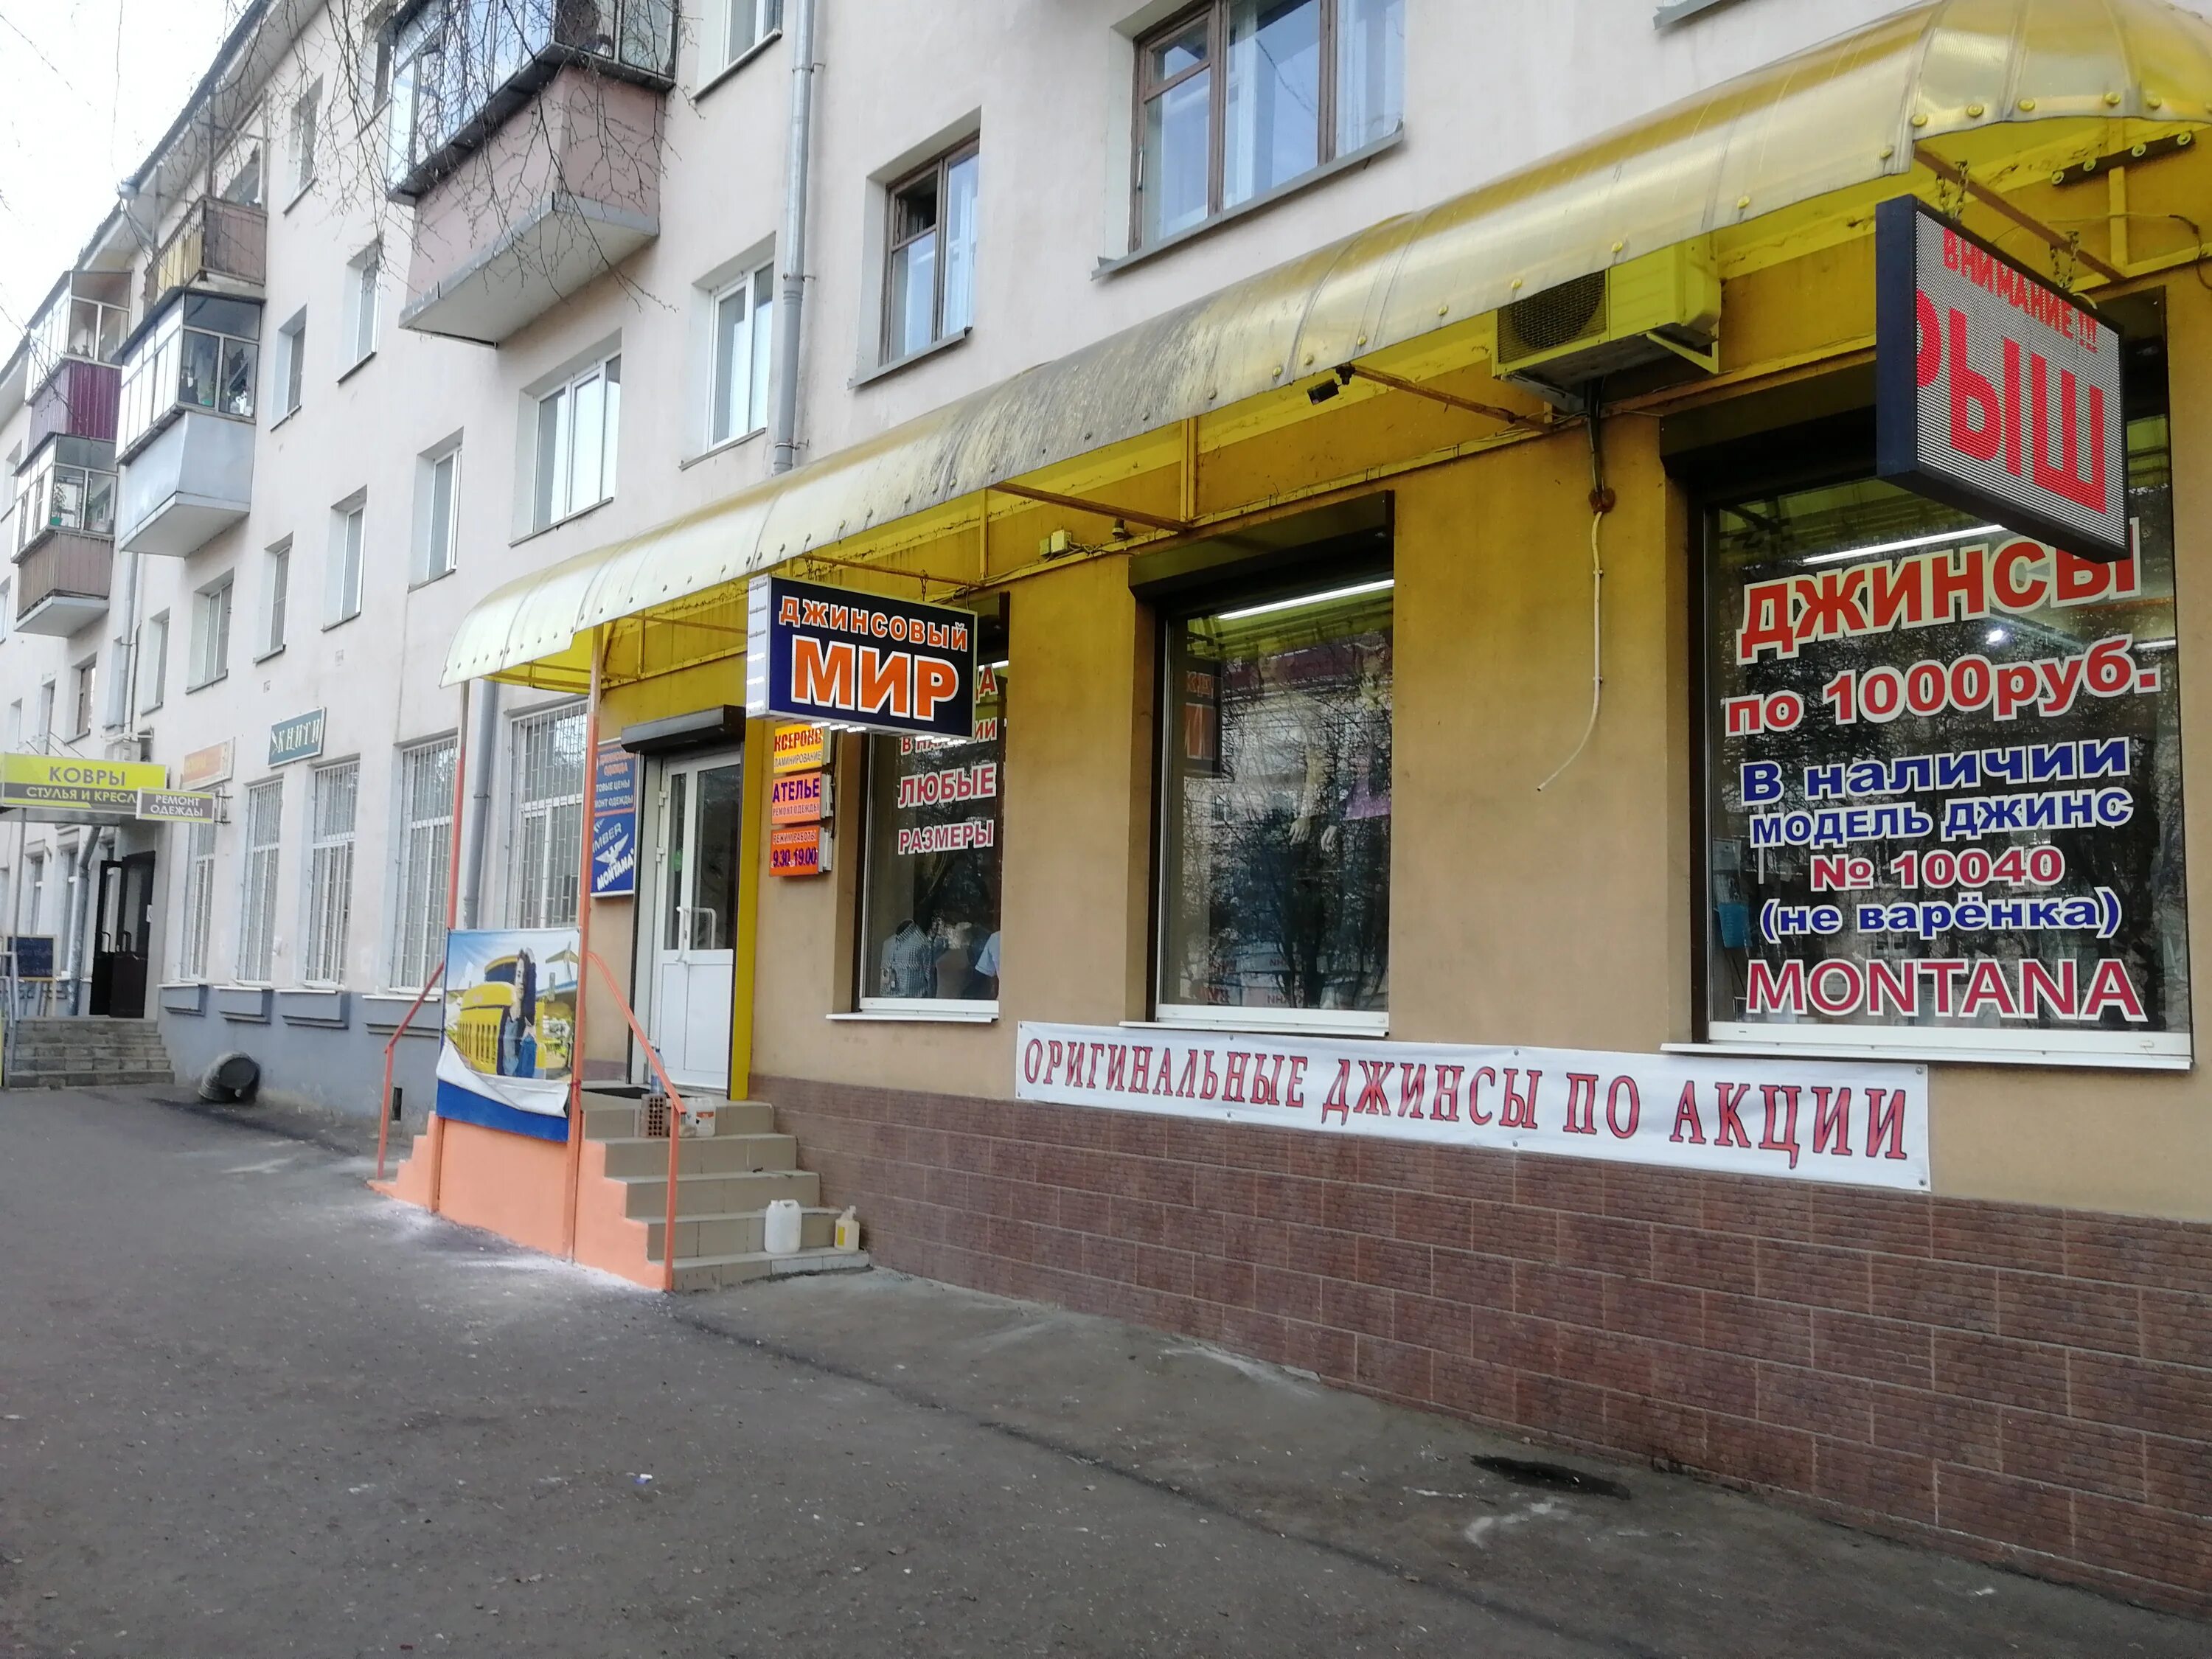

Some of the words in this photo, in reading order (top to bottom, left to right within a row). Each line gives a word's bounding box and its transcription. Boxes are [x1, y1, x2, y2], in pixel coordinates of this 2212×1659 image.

[1737, 518, 2141, 664] ДЖИНСЫ
[779, 595, 968, 653] ДЖИНСОВЫЙ
[791, 634, 959, 722] МИР
[1725, 691, 1803, 737] по
[1823, 635, 2161, 726] 1000руб.
[774, 727, 823, 752] КСЕРОКС
[49, 765, 126, 787] КОВРЫ
[774, 751, 822, 768] ЛАМИНИРОВАНИЕ
[1740, 760, 1784, 807] В
[1804, 737, 2130, 799] наличии
[27, 786, 77, 801] СТУЛЬЯ
[81, 789, 90, 801] И
[94, 790, 136, 804] КРЕСЛ
[155, 795, 201, 807] РЕМОНТ
[596, 782, 613, 793] ТОВЫЕ
[613, 779, 630, 790] ЦЕНЫ
[608, 794, 633, 807] ОДЕЖДЫ
[773, 777, 820, 803] АТЕЛЬЕ
[897, 762, 997, 809] ЛЮБЫЕ
[150, 803, 204, 818] ОДЕЖДЫ
[773, 806, 793, 817] РЕМОНТ
[793, 802, 819, 815] ОДЕЖДЫ
[1750, 804, 1933, 849] МОДЕЛЬ
[1941, 787, 2133, 842] ДЖИНС
[793, 830, 817, 843] РАБОТЫ
[897, 819, 995, 855] РАЗМЕРЫ
[1811, 852, 1874, 892] №
[1891, 846, 2065, 888] 10040
[1759, 897, 1843, 943] (не
[1858, 886, 2123, 941] варёнка)
[1745, 958, 2148, 1023] MONTANA
[1024, 1037, 1308, 1108] ОРИГИНАЛЬНЫЕ
[1321, 1058, 1543, 1130] ДЖИНСЫ
[1562, 1071, 1641, 1139] ПО
[1669, 1080, 1907, 1169] АКЦИИ
